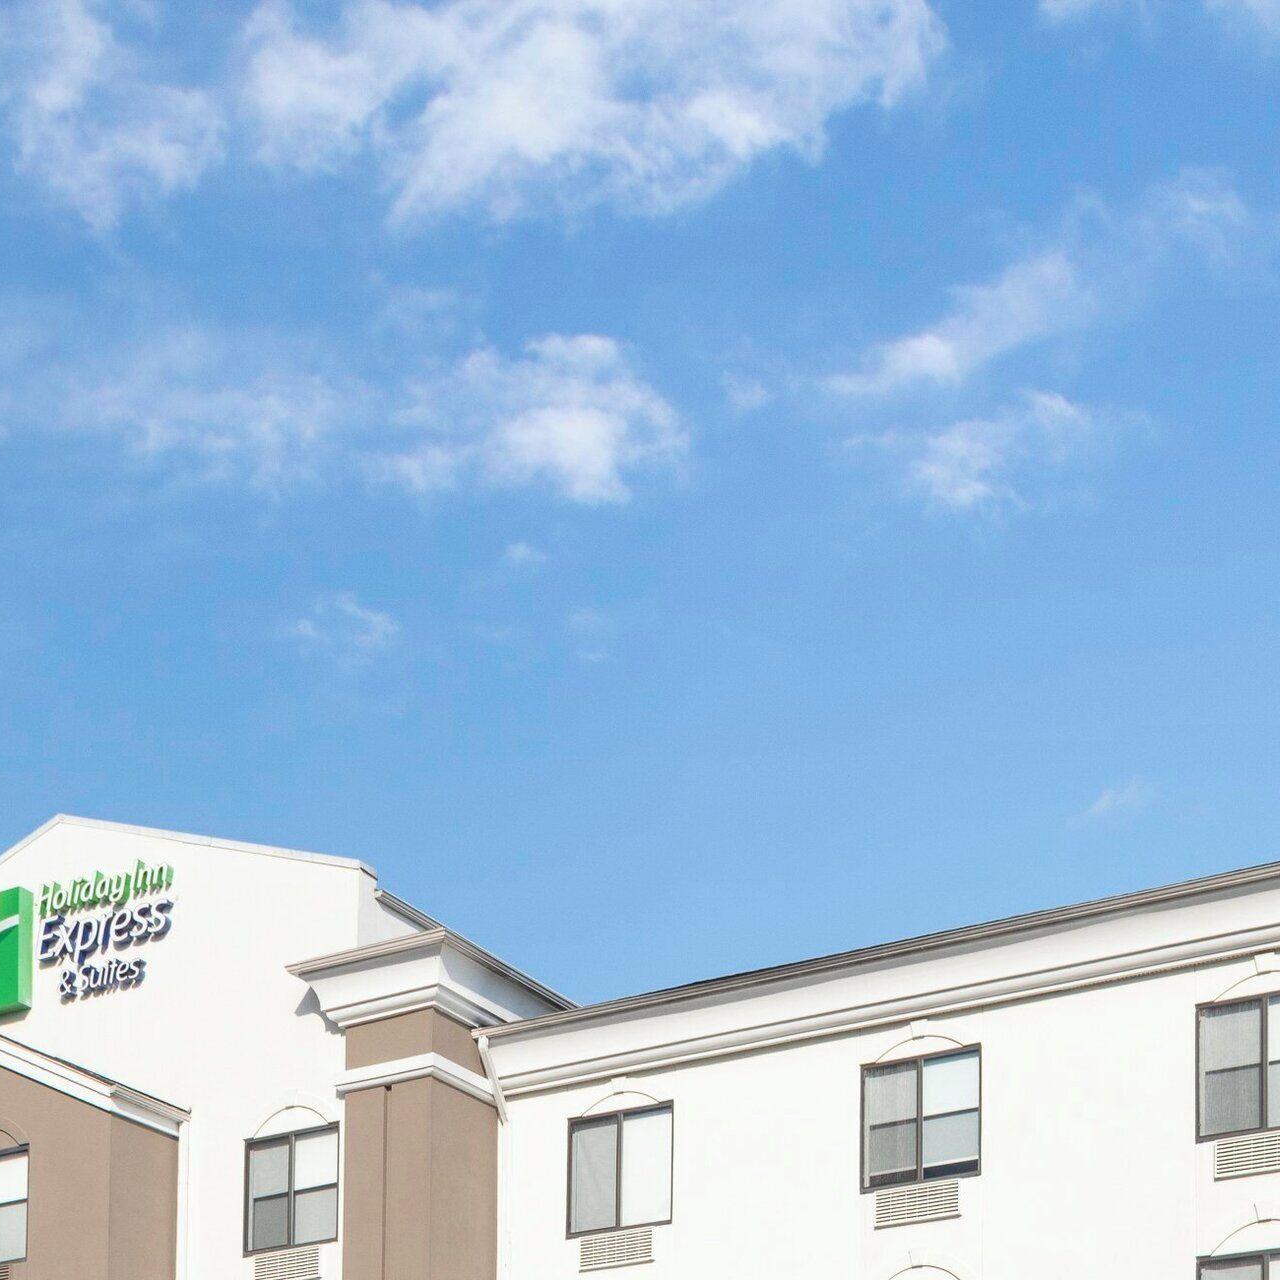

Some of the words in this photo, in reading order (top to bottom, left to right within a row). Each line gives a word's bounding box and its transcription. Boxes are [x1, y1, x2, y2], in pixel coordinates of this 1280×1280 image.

[39, 872, 130, 917] Holiday
[132, 859, 173, 892] Inn
[38, 900, 173, 964] Express
[59, 968, 76, 995] &
[74, 958, 146, 992] Suites
